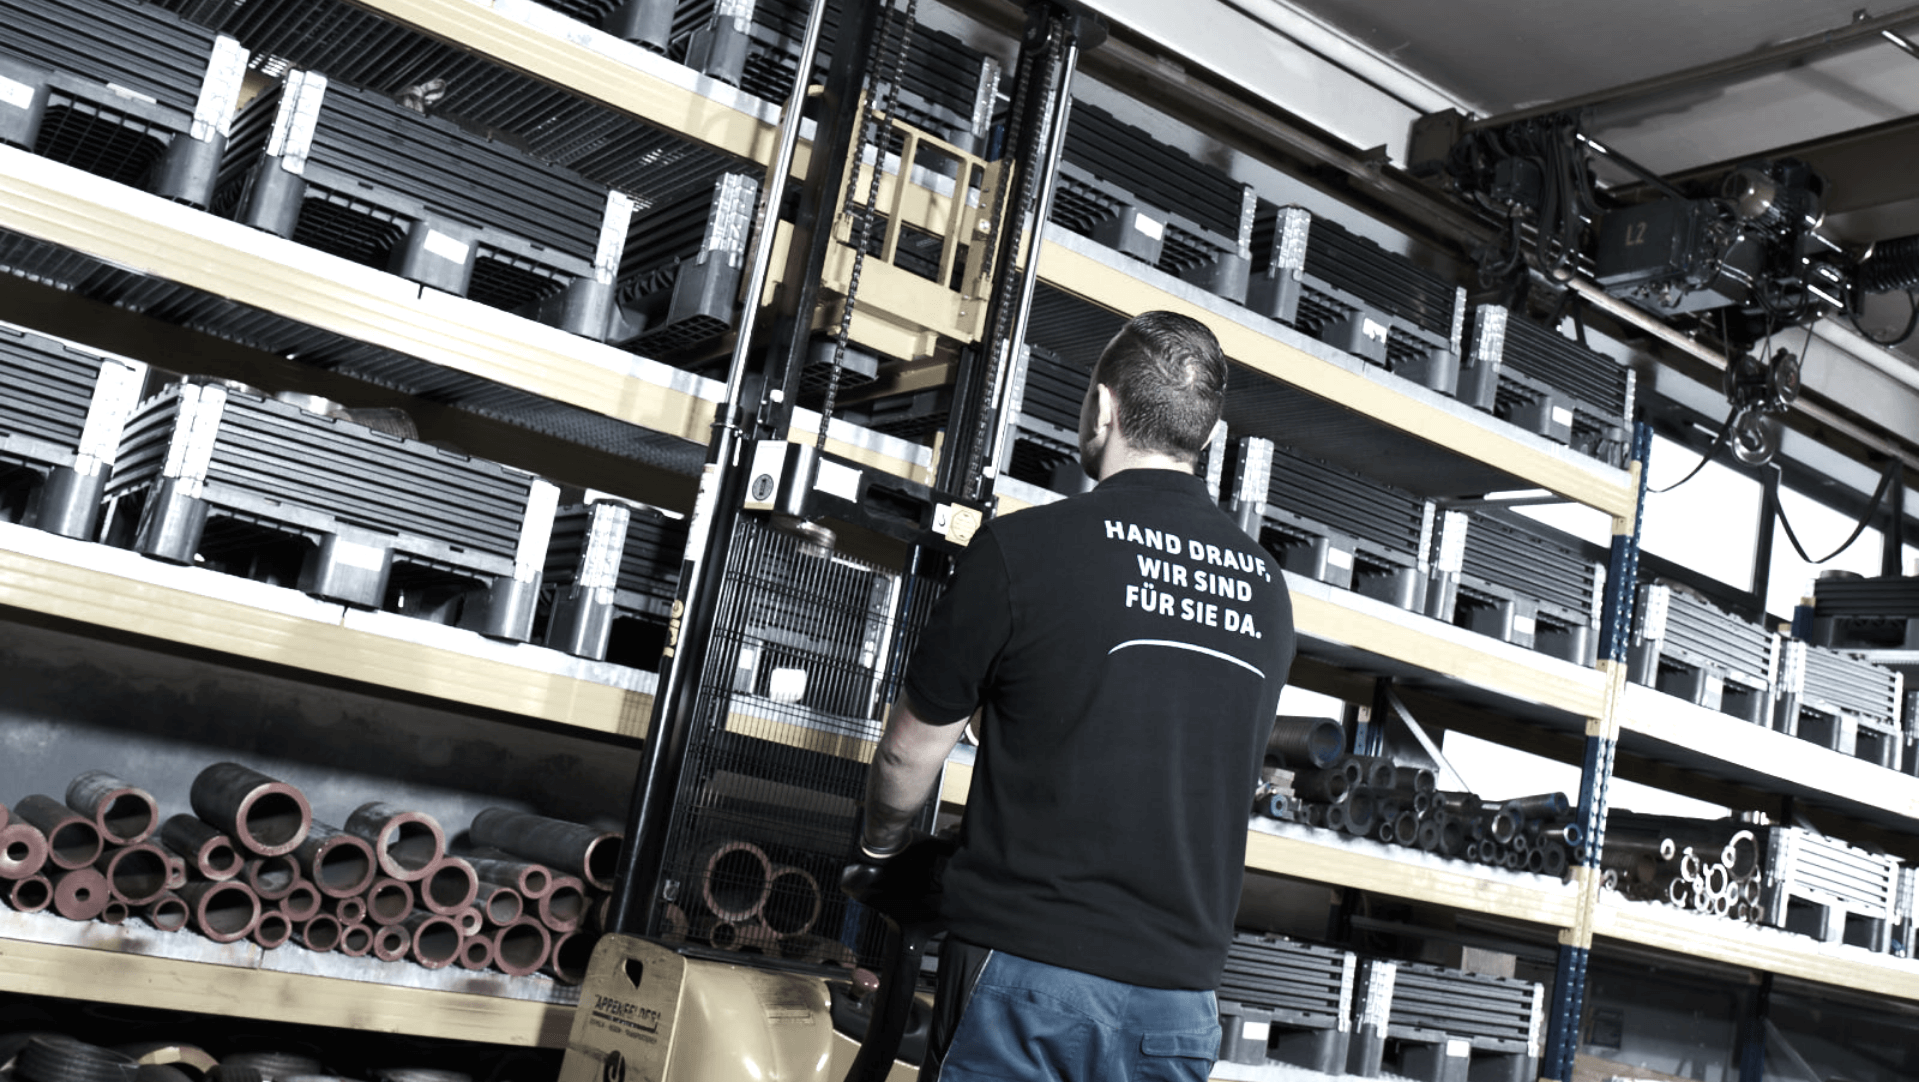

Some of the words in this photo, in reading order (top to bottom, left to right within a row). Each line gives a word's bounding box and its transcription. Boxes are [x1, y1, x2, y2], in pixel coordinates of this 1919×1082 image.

[1624, 222, 1647, 247] L2
[1104, 519, 1181, 555] HAND
[1188, 539, 1271, 583] DRAUF,
[1136, 554, 1188, 588] WIR
[1193, 570, 1252, 602] SIND
[1125, 582, 1175, 617] FÜR
[1180, 598, 1218, 628] SIE
[1224, 608, 1262, 639] DA.
